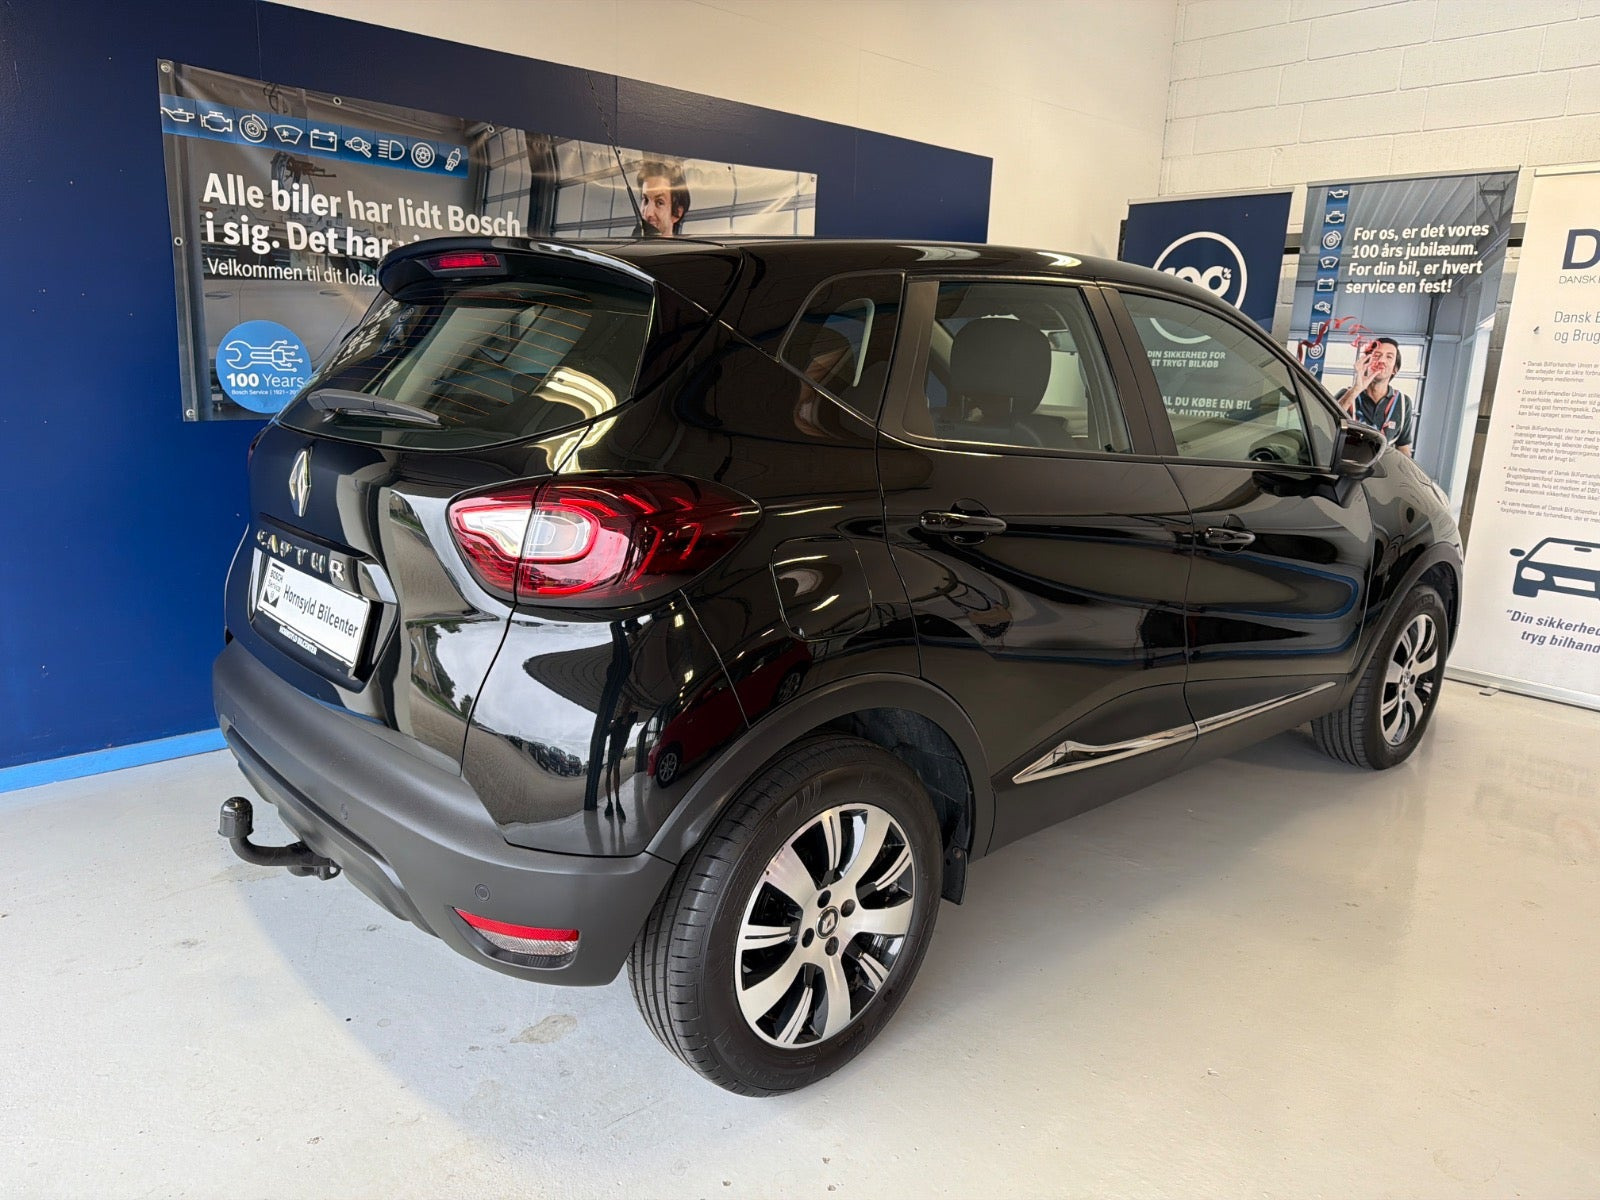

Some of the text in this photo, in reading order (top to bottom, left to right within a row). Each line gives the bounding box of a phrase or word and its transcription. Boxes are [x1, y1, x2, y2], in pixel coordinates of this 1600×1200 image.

[202, 172, 521, 238] Alle biler har lidt Bosch
[205, 212, 392, 259] i sig. Det har
[1353, 223, 1490, 241] For os, er det vores
[1351, 241, 1479, 260] 100 års jubilæum.
[207, 257, 303, 281] Velkommen
[306, 265, 321, 282] til
[323, 267, 343, 284] dit
[1348, 260, 1483, 277] For din bil, er hvert
[1345, 279, 1453, 294] service en fest!
[1559, 275, 1597, 284] DANSK
[1554, 310, 1592, 323] Dansk
[1554, 328, 1600, 344] og Brug
[1163, 351, 1208, 359] SIKKERHED
[1209, 352, 1226, 360] FOR
[1188, 360, 1219, 368] BILKØB
[226, 373, 305, 389] 100 Years
[1175, 396, 1189, 406] DU
[1192, 398, 1218, 408] KØBE
[1220, 399, 1234, 409] EN
[1236, 400, 1252, 410] BIL
[256, 529, 346, 582] CAPTUR
[270, 569, 284, 583] BOSCH
[283, 584, 358, 638] Hornsyld Bilcenter
[1521, 630, 1547, 646] tryg
